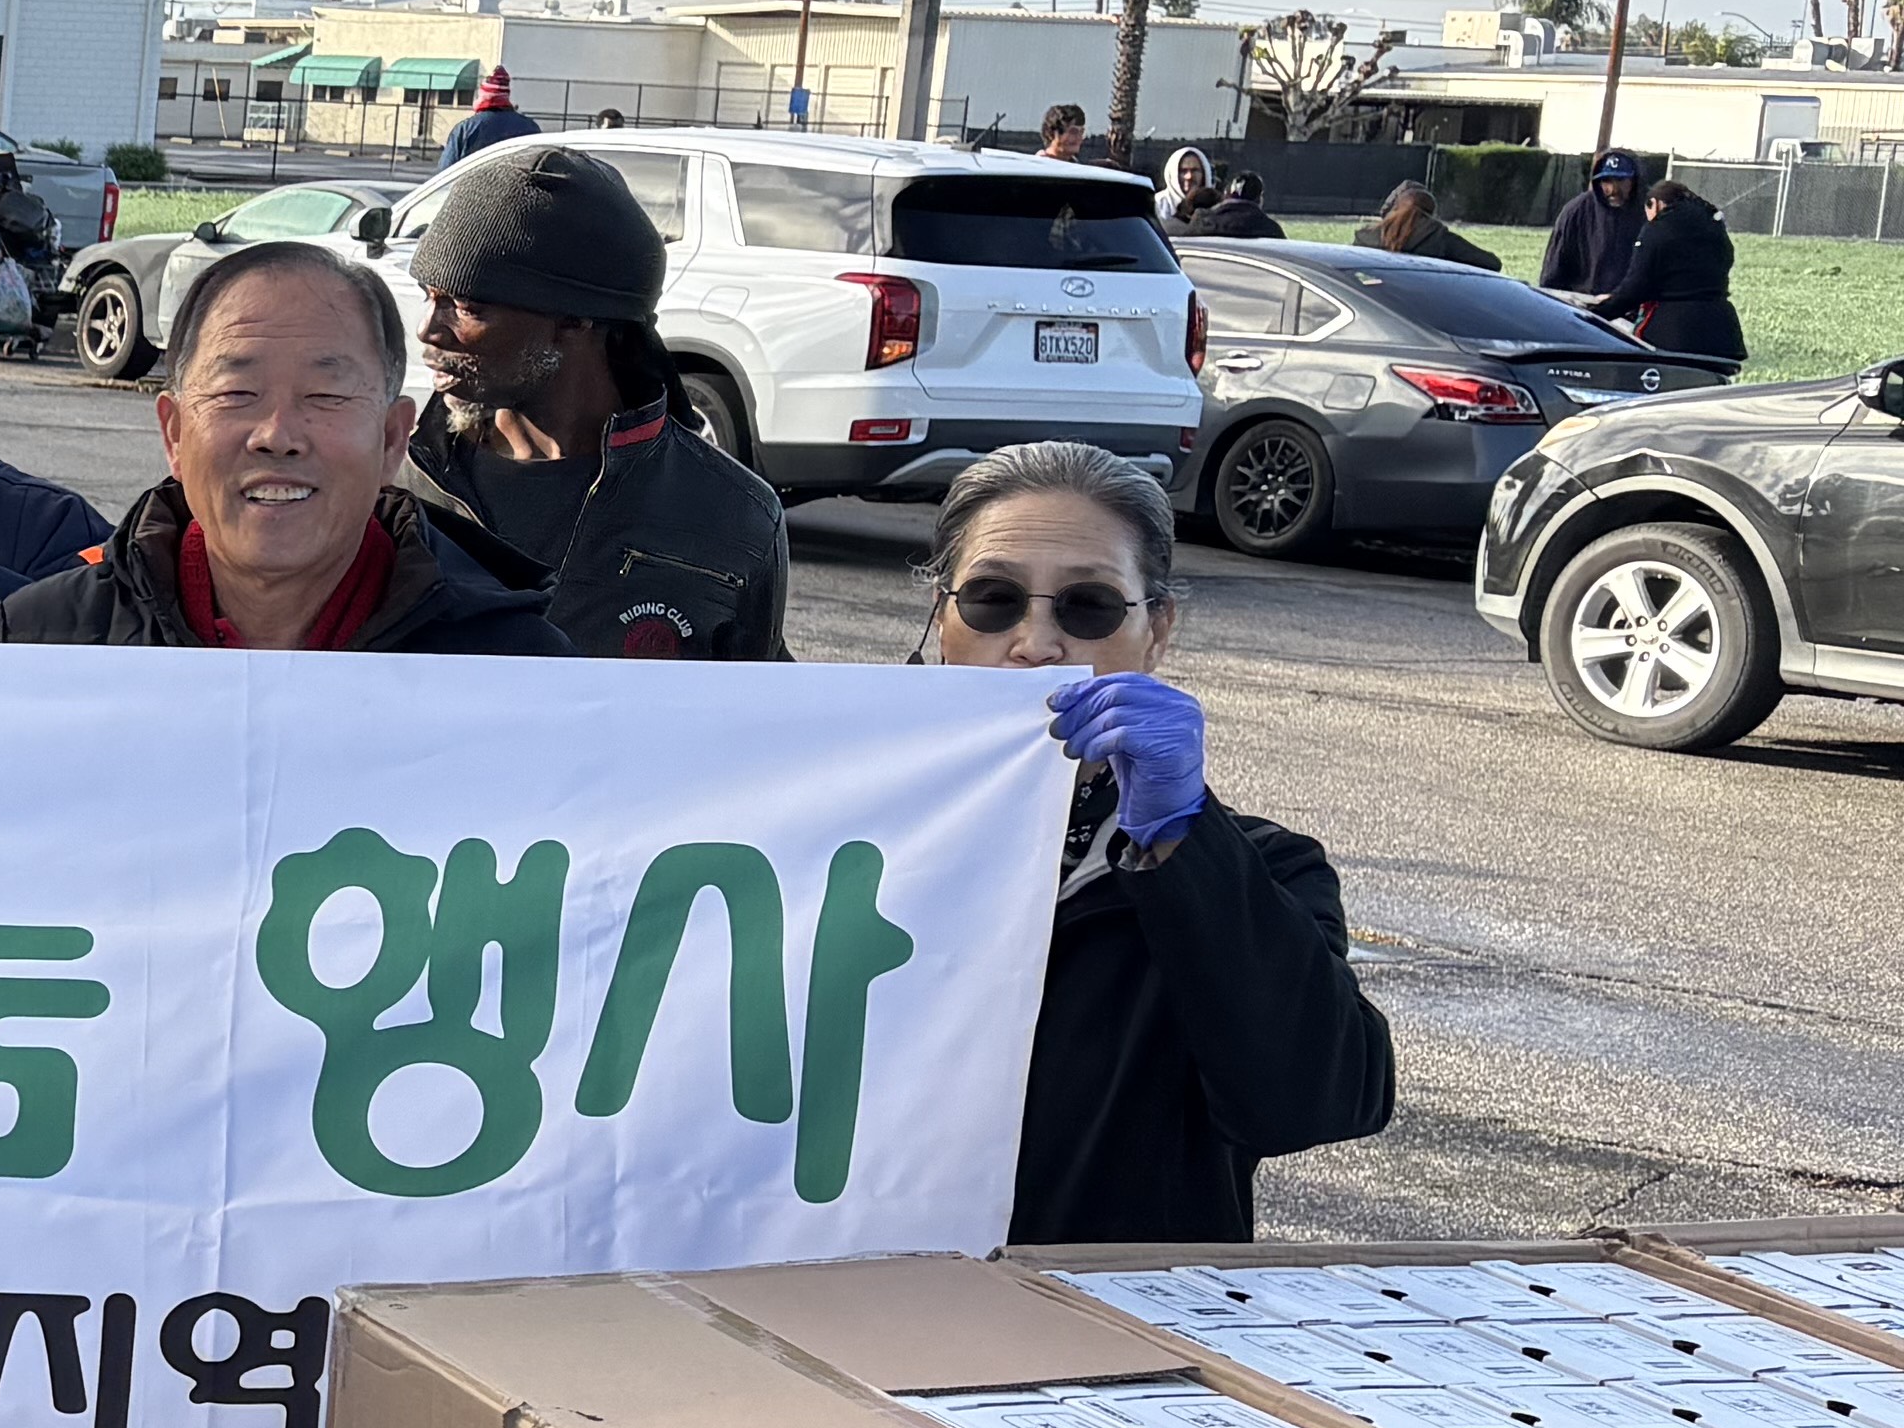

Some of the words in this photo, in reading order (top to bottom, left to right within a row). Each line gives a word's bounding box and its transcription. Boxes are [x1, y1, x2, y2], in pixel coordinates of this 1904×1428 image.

[1040, 335, 1093, 354] 8TKX520
[619, 602, 666, 624] RIDING
[667, 608, 693, 638] CLUB
[256, 827, 914, 1204] 행사
